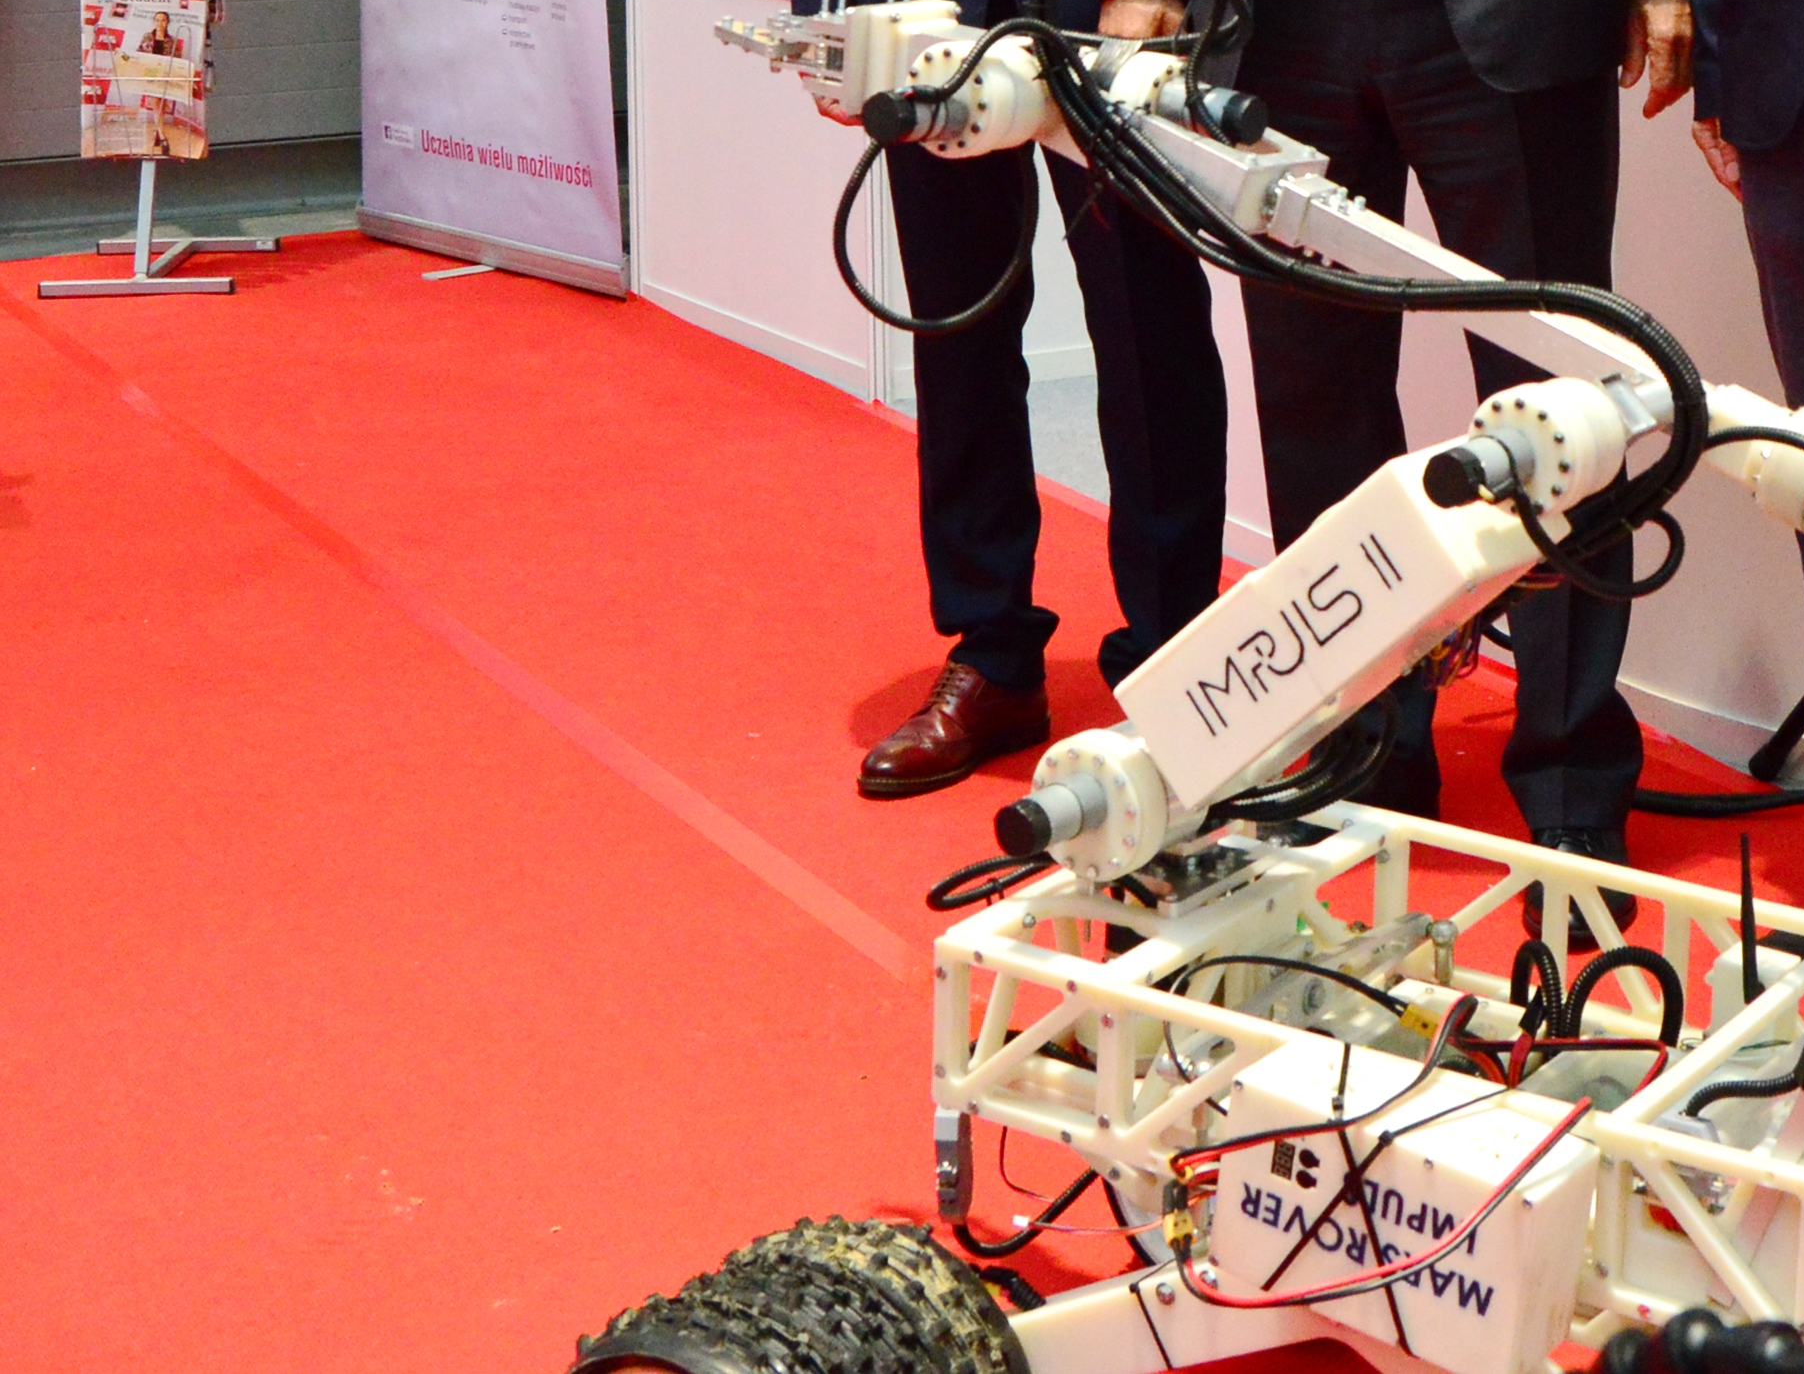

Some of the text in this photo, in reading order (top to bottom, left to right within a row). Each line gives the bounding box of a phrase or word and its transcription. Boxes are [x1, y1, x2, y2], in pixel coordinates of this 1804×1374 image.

[421, 129, 474, 163] Uczelnia
[477, 142, 513, 171] wielu
[517, 154, 593, 188] możliwości
[1240, 1182, 1368, 1266] ROVER
